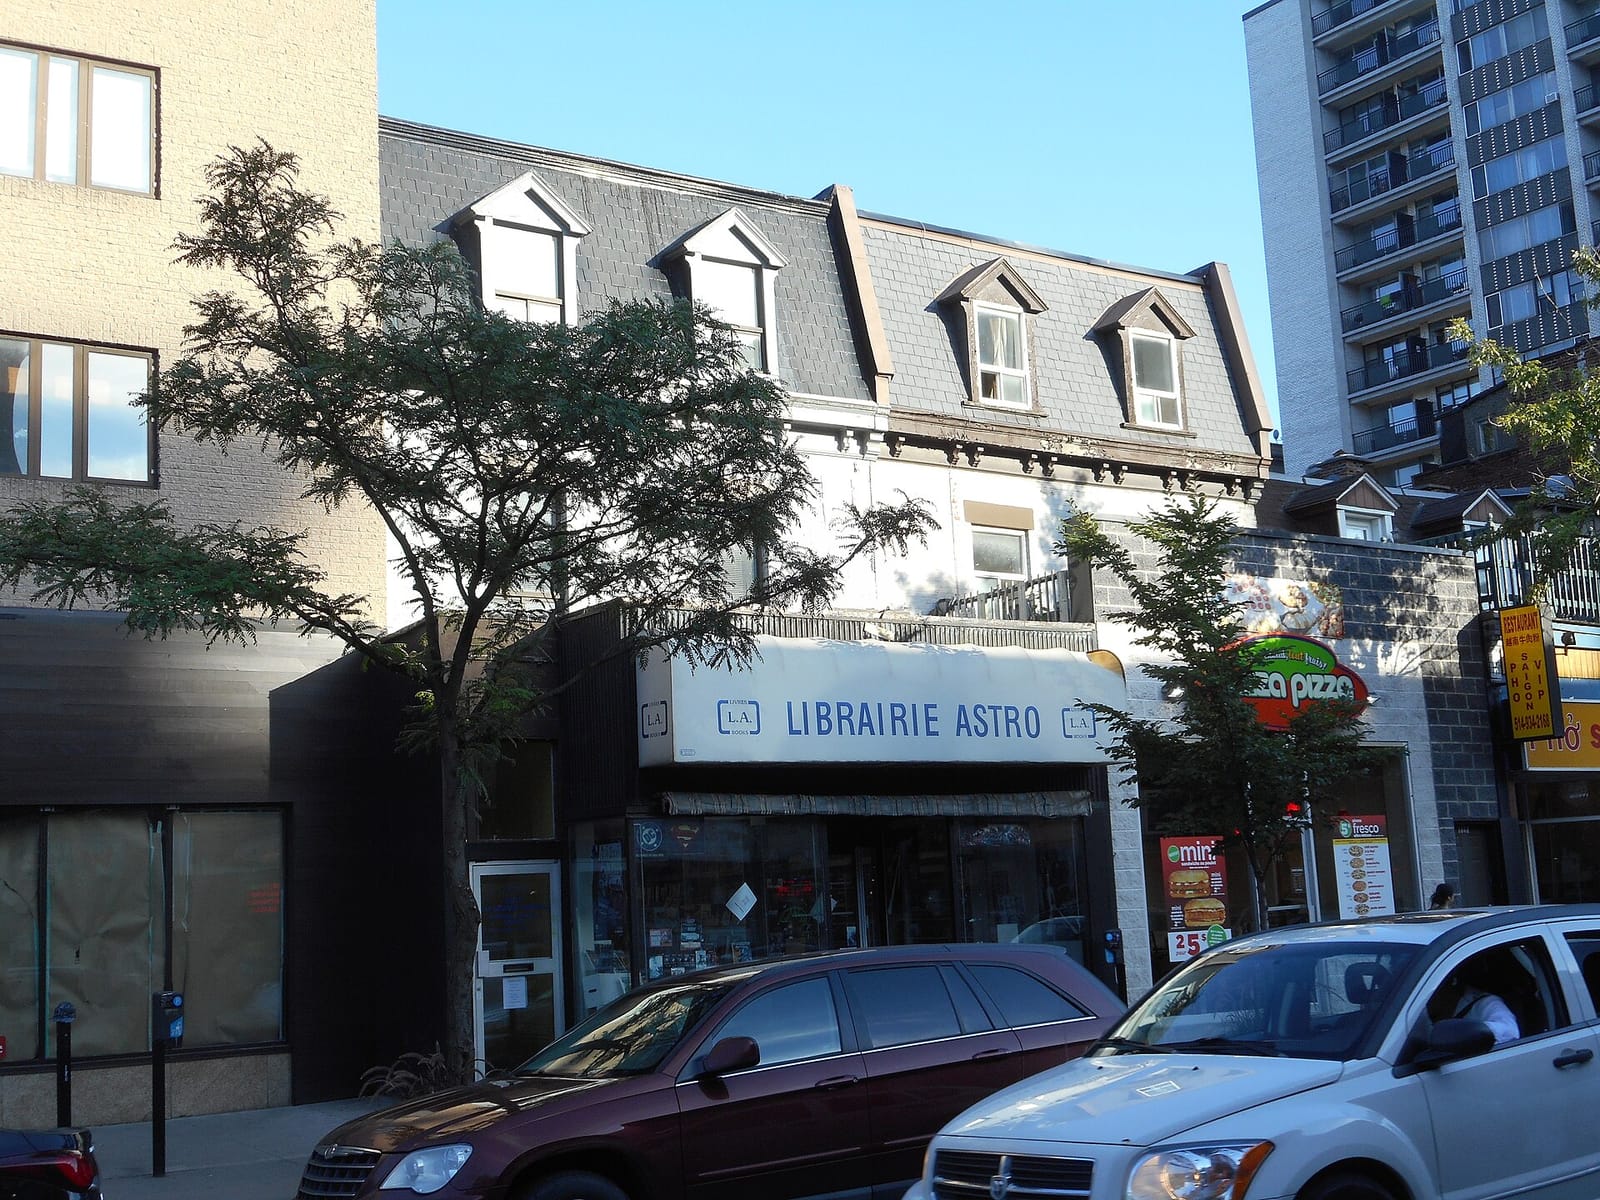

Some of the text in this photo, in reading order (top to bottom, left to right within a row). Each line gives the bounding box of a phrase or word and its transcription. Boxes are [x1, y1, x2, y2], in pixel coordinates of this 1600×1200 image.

[1503, 611, 1538, 633] RESTAURANT
[647, 713, 663, 726] L.A.
[728, 711, 753, 723] L.A.
[786, 700, 1041, 739] LIBRAIRIE ASTRO
[1352, 822, 1380, 834] fresco
[1175, 934, 1185, 949] 2
